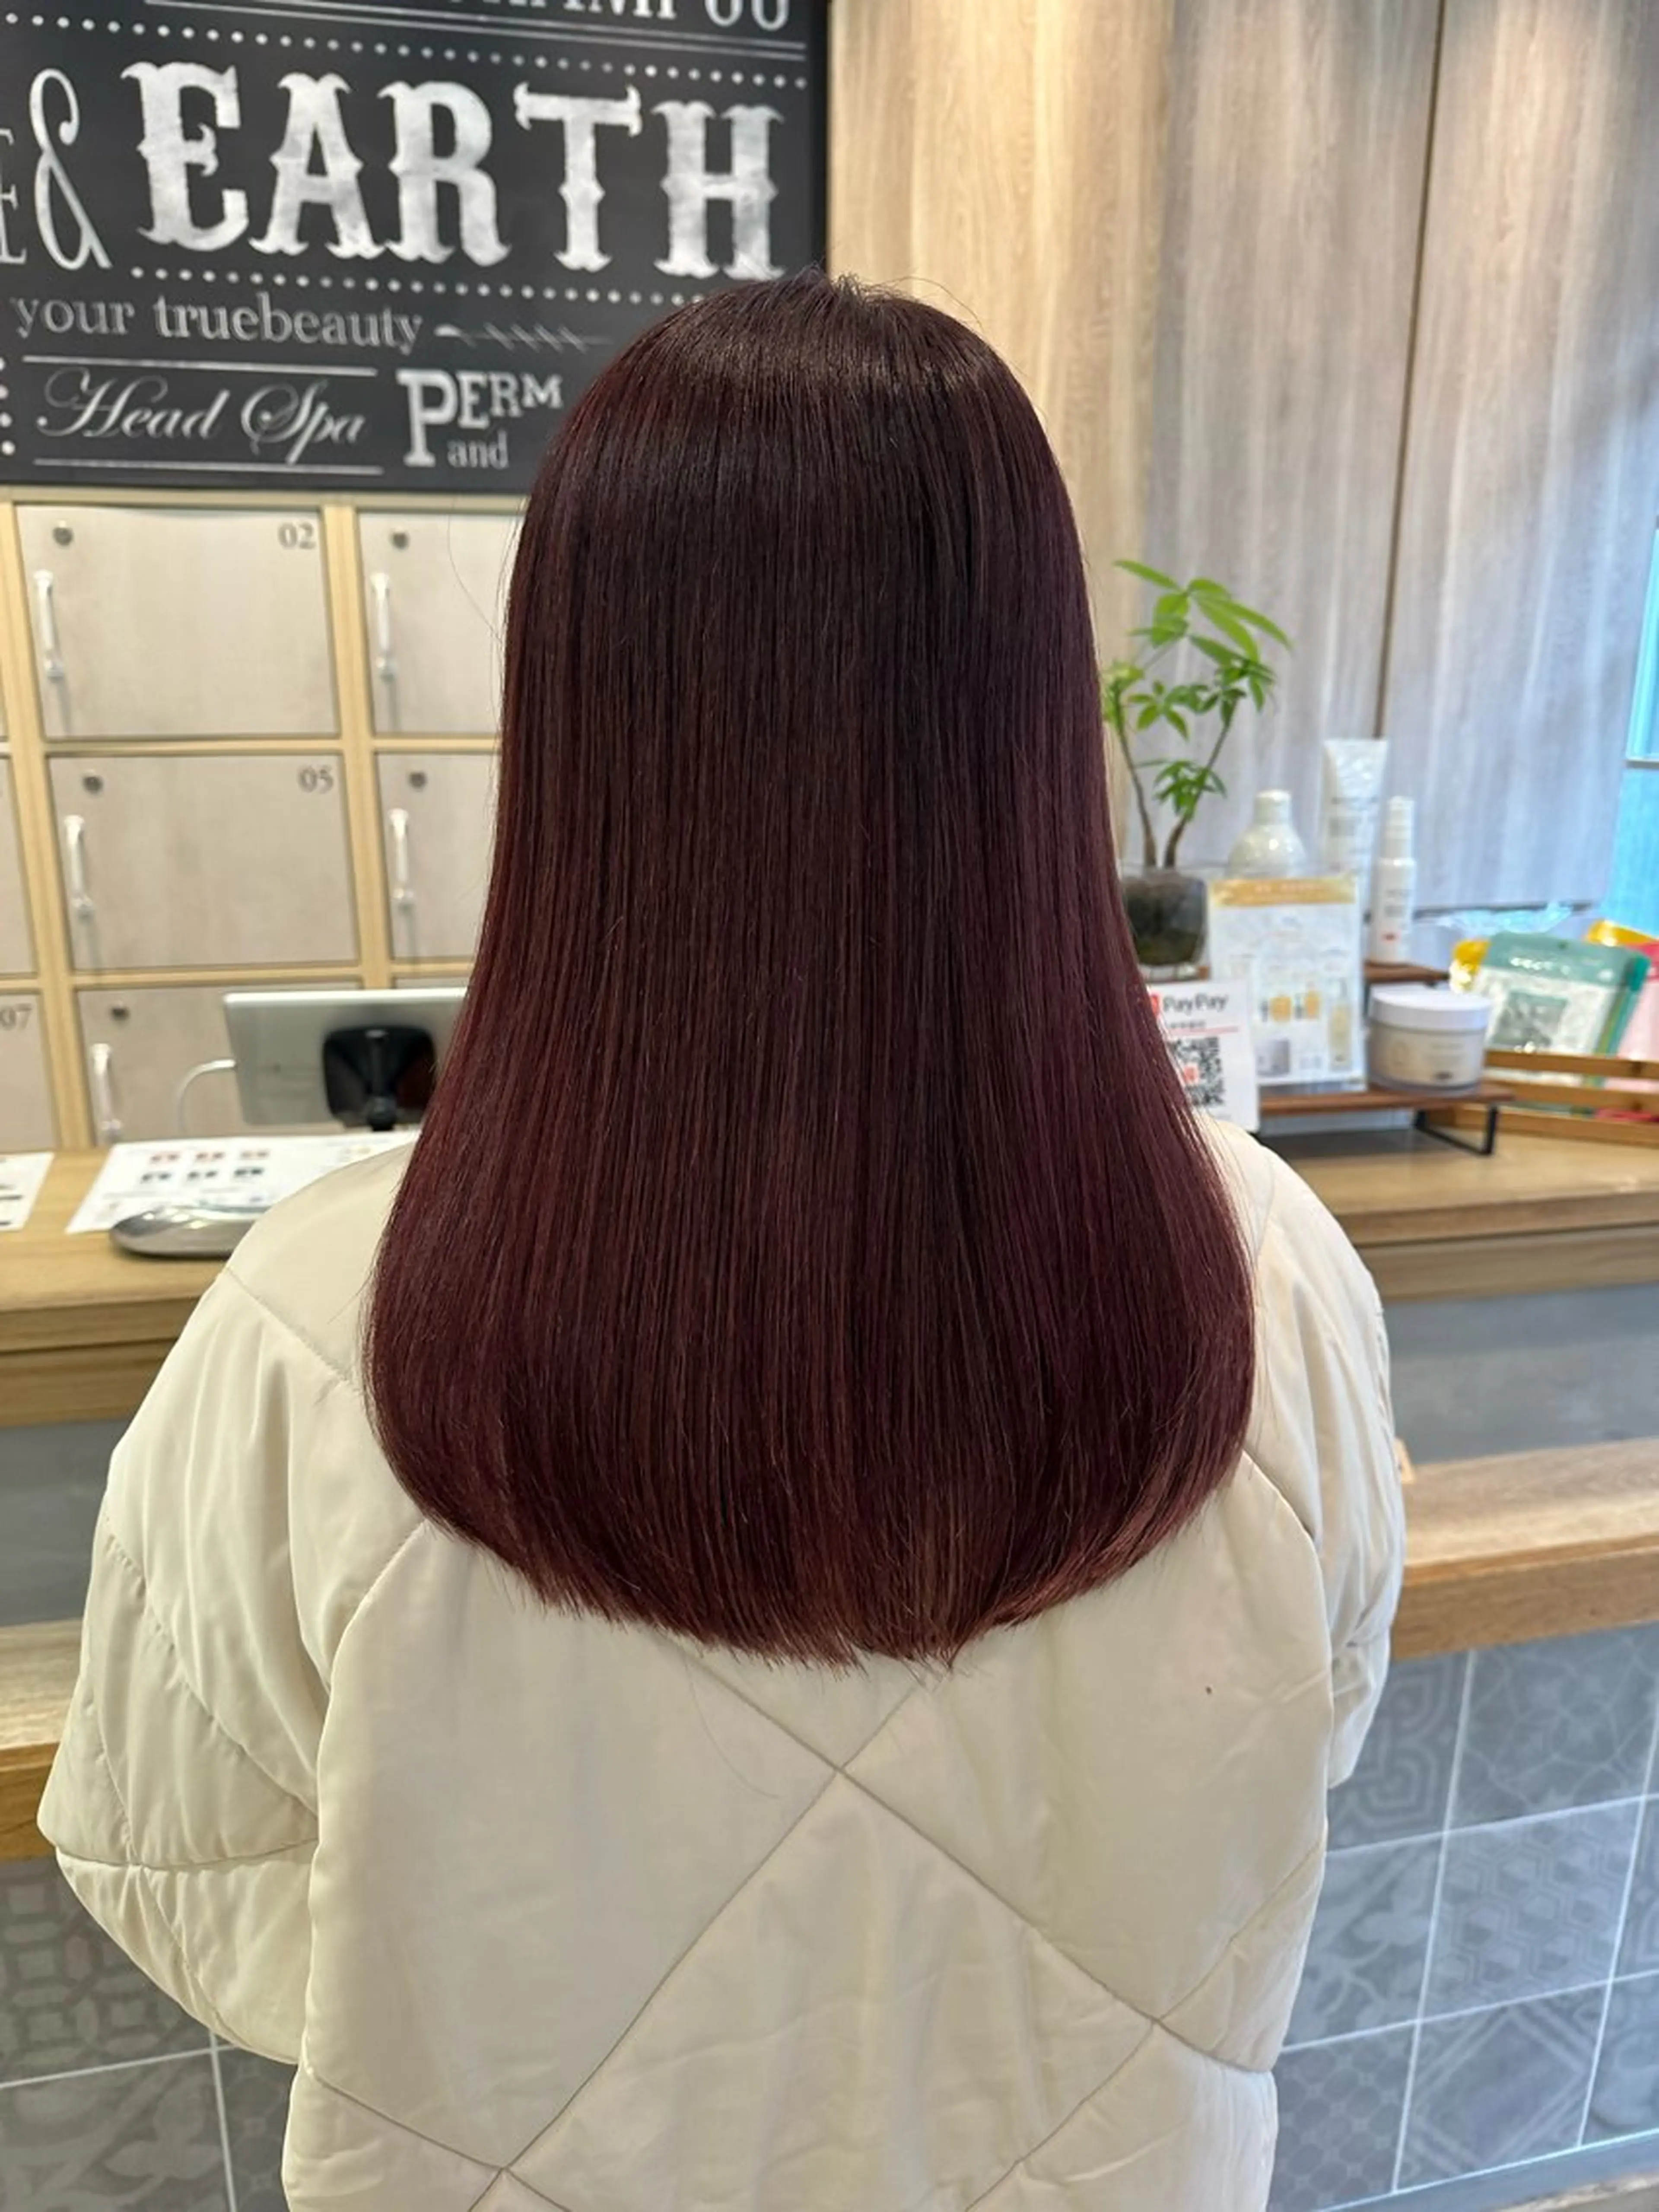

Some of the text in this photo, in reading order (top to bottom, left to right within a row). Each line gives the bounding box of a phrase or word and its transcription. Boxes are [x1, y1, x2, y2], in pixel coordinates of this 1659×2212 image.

[29, 68, 112, 270] &
[121, 62, 785, 280] EARTH
[12, 292, 423, 355] your truebeauty
[36, 367, 366, 464] Head Spa
[396, 369, 563, 467] PERM
[447, 430, 509, 469] and
[278, 522, 317, 550] 02
[298, 764, 334, 793] 05
[0, 1003, 32, 1030] 07
[1163, 993, 1228, 1016] PayPay
